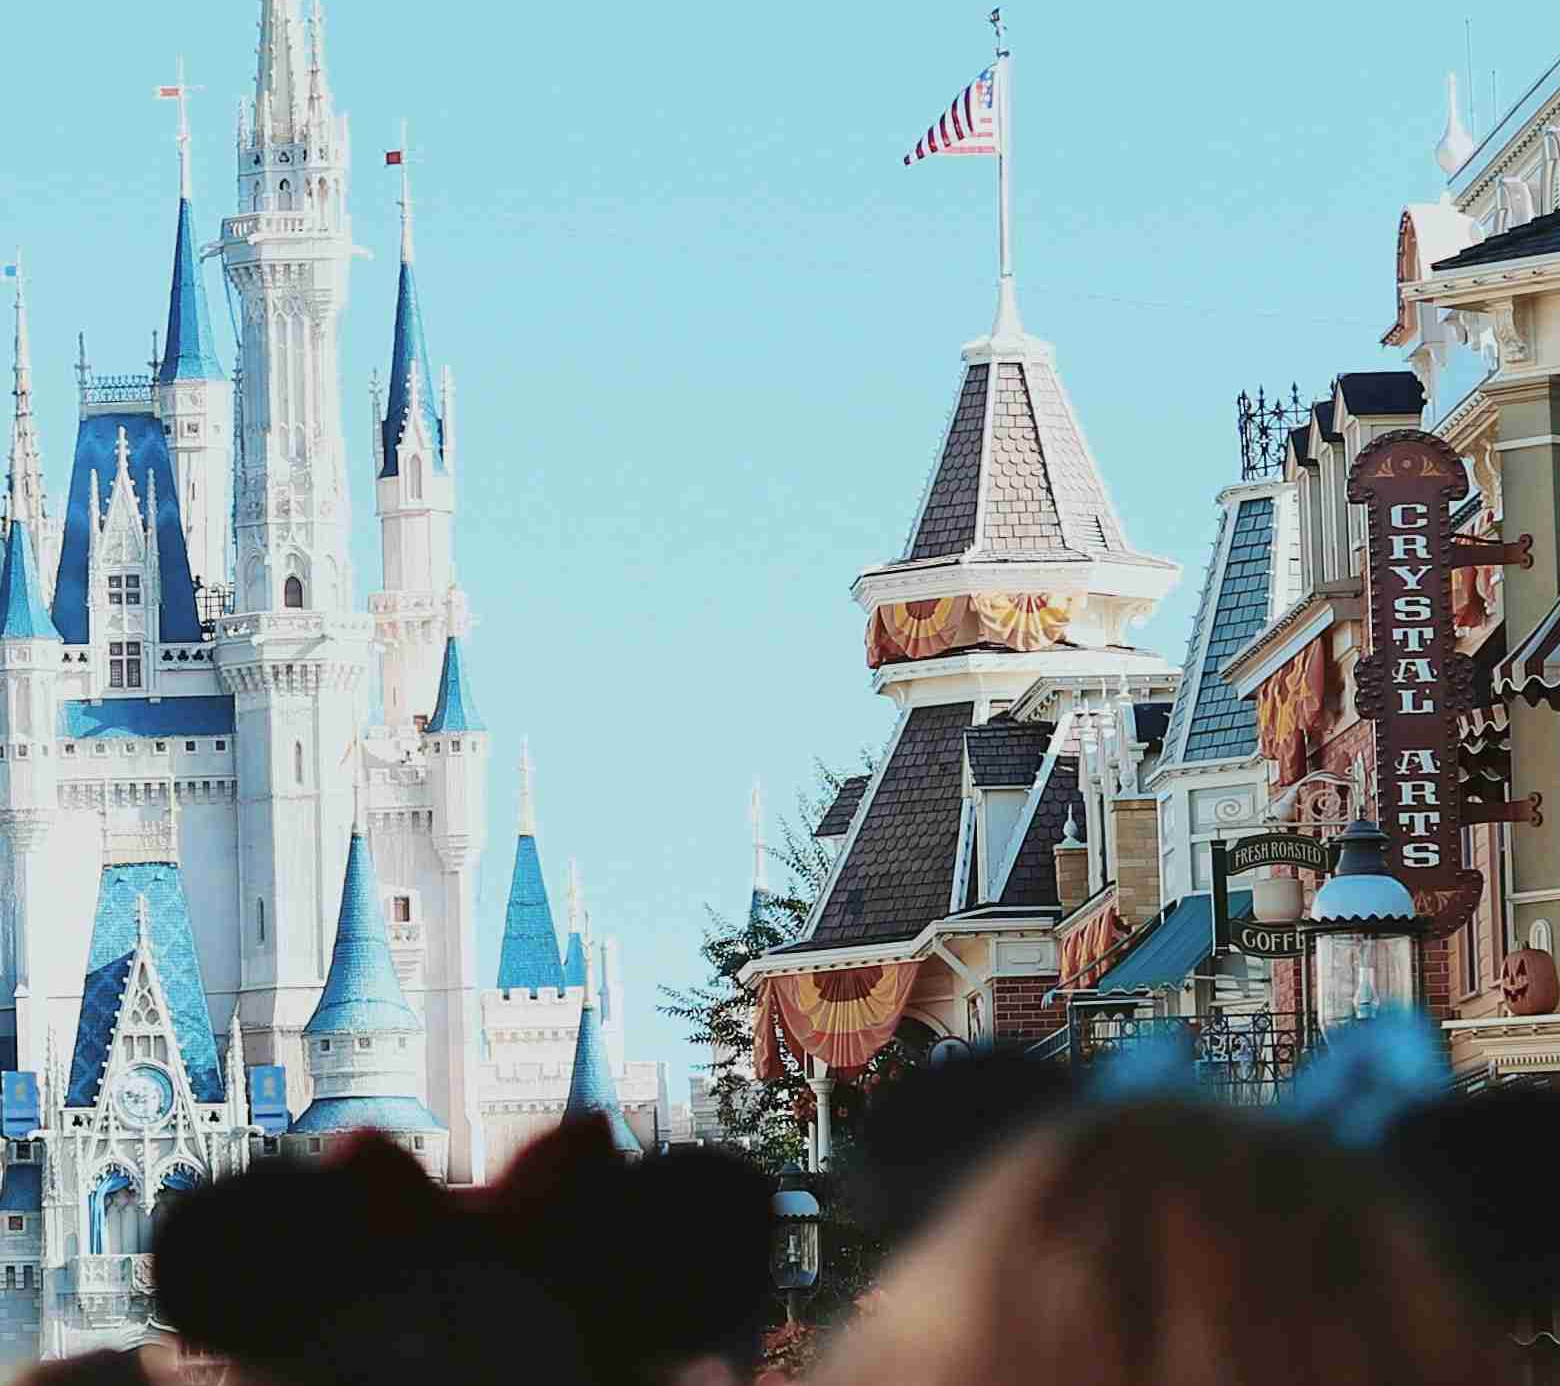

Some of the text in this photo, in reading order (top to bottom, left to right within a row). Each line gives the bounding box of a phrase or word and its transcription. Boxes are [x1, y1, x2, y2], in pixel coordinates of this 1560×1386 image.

[1388, 502, 1440, 867] CRYSTAL ARTS
[1235, 841, 1321, 867] FRESH ROASTED
[1242, 929, 1304, 952] COFFE
